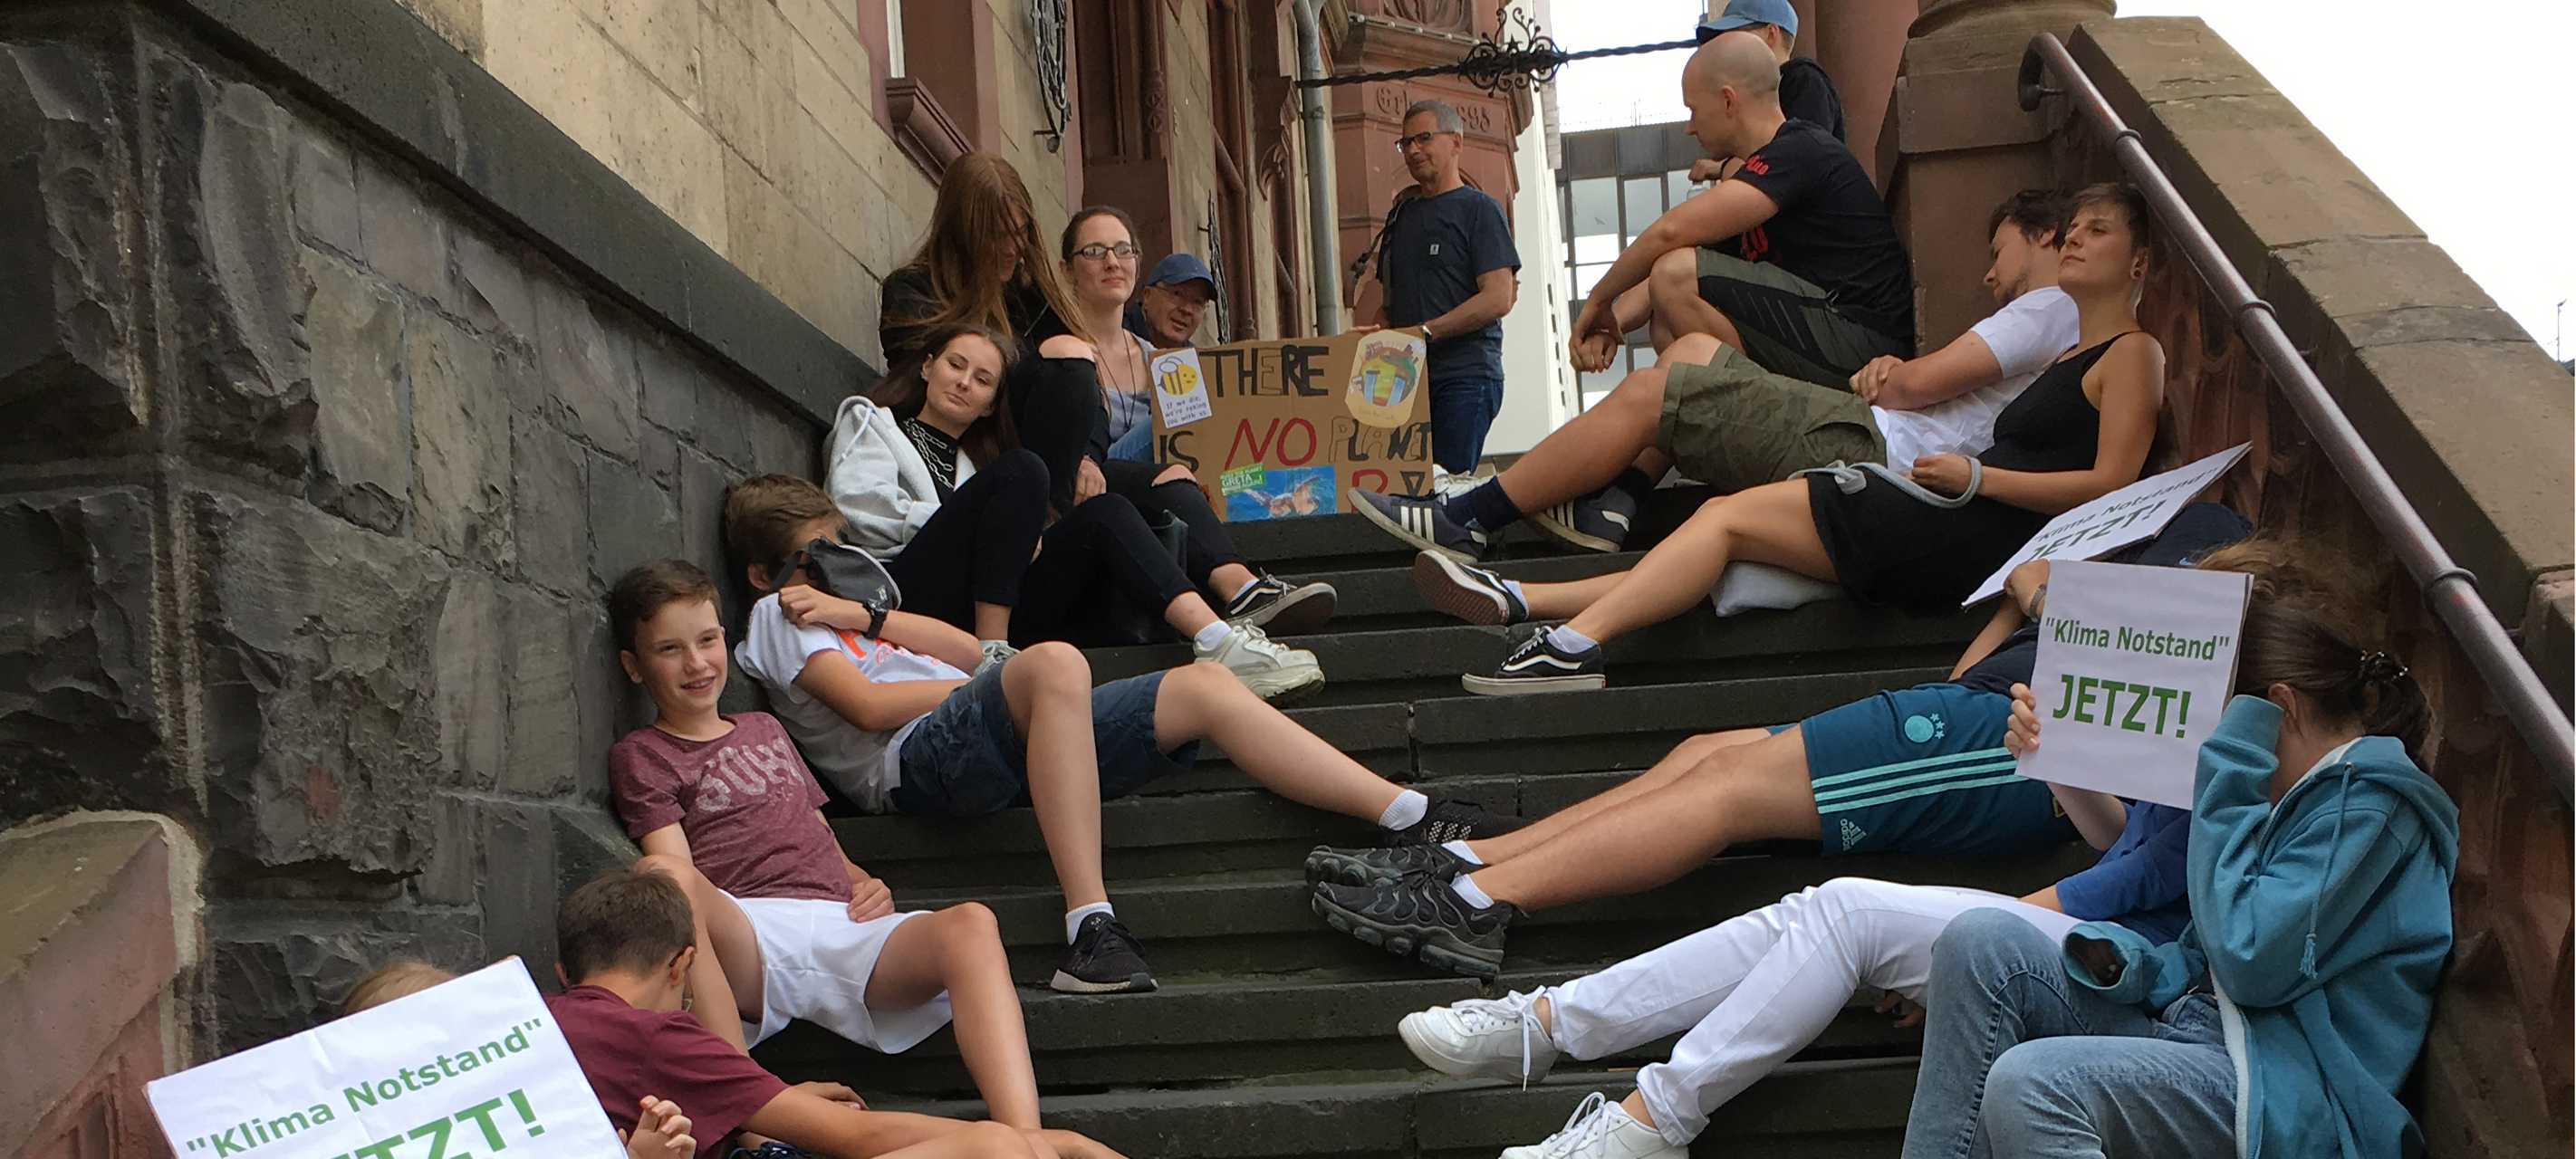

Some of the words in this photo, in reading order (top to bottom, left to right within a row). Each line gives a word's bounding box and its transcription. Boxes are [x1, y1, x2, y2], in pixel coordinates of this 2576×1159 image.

[1199, 344, 1329, 398] THERE
[1166, 401, 1173, 410] If
[1167, 418, 1177, 427] you
[1181, 412, 1196, 422] with
[1186, 402, 1206, 412] taking
[1160, 431, 1199, 472] IS
[1225, 417, 1317, 470] NO
[1328, 416, 1431, 463] PLANET
[1222, 474, 1253, 487] GRETA
[2034, 513, 2096, 541] "Klima
[2101, 466, 2219, 516] Notstand"
[2025, 499, 2167, 563] JETZT!
[2044, 617, 2110, 648] "Klima
[2117, 626, 2230, 661] Notstand"
[2052, 674, 2192, 739] JETZT!
[186, 1102, 336, 1159] "Klima
[343, 1019, 543, 1113] Notstand"
[322, 1088, 545, 1159] TZT!
